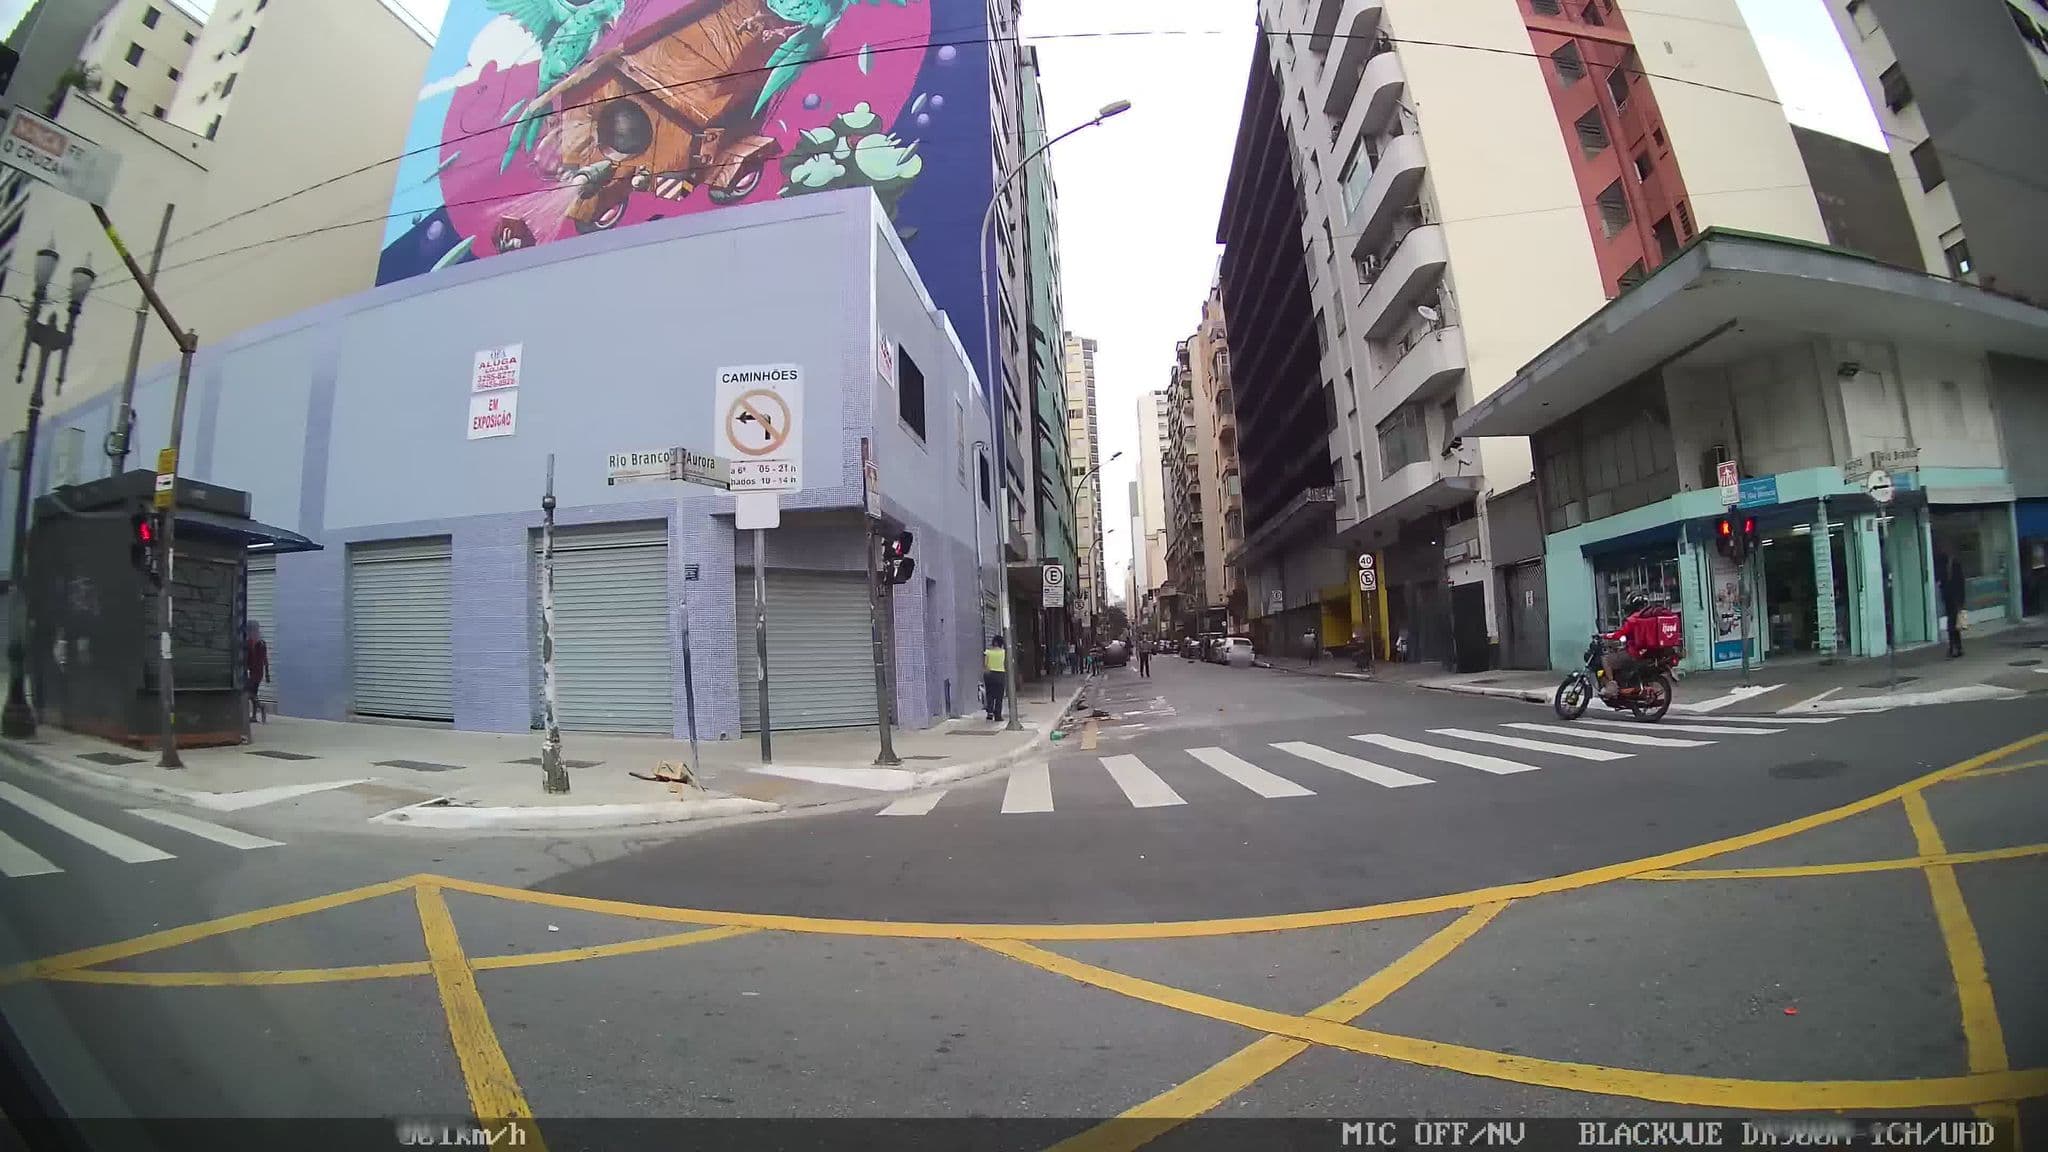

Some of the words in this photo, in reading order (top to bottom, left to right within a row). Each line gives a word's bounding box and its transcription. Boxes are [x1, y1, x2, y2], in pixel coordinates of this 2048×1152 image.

[479, 357, 517, 369] ALUGA
[722, 369, 798, 383] CAMINHÕES
[489, 398, 499, 411] EM
[609, 453, 626, 468] Rio
[631, 451, 670, 466] Branco
[686, 451, 715, 469] Aurora
[759, 464, 770, 473] 05
[778, 464, 788, 473] 21
[1360, 556, 1372, 565] 40
[1050, 570, 1058, 581] E
